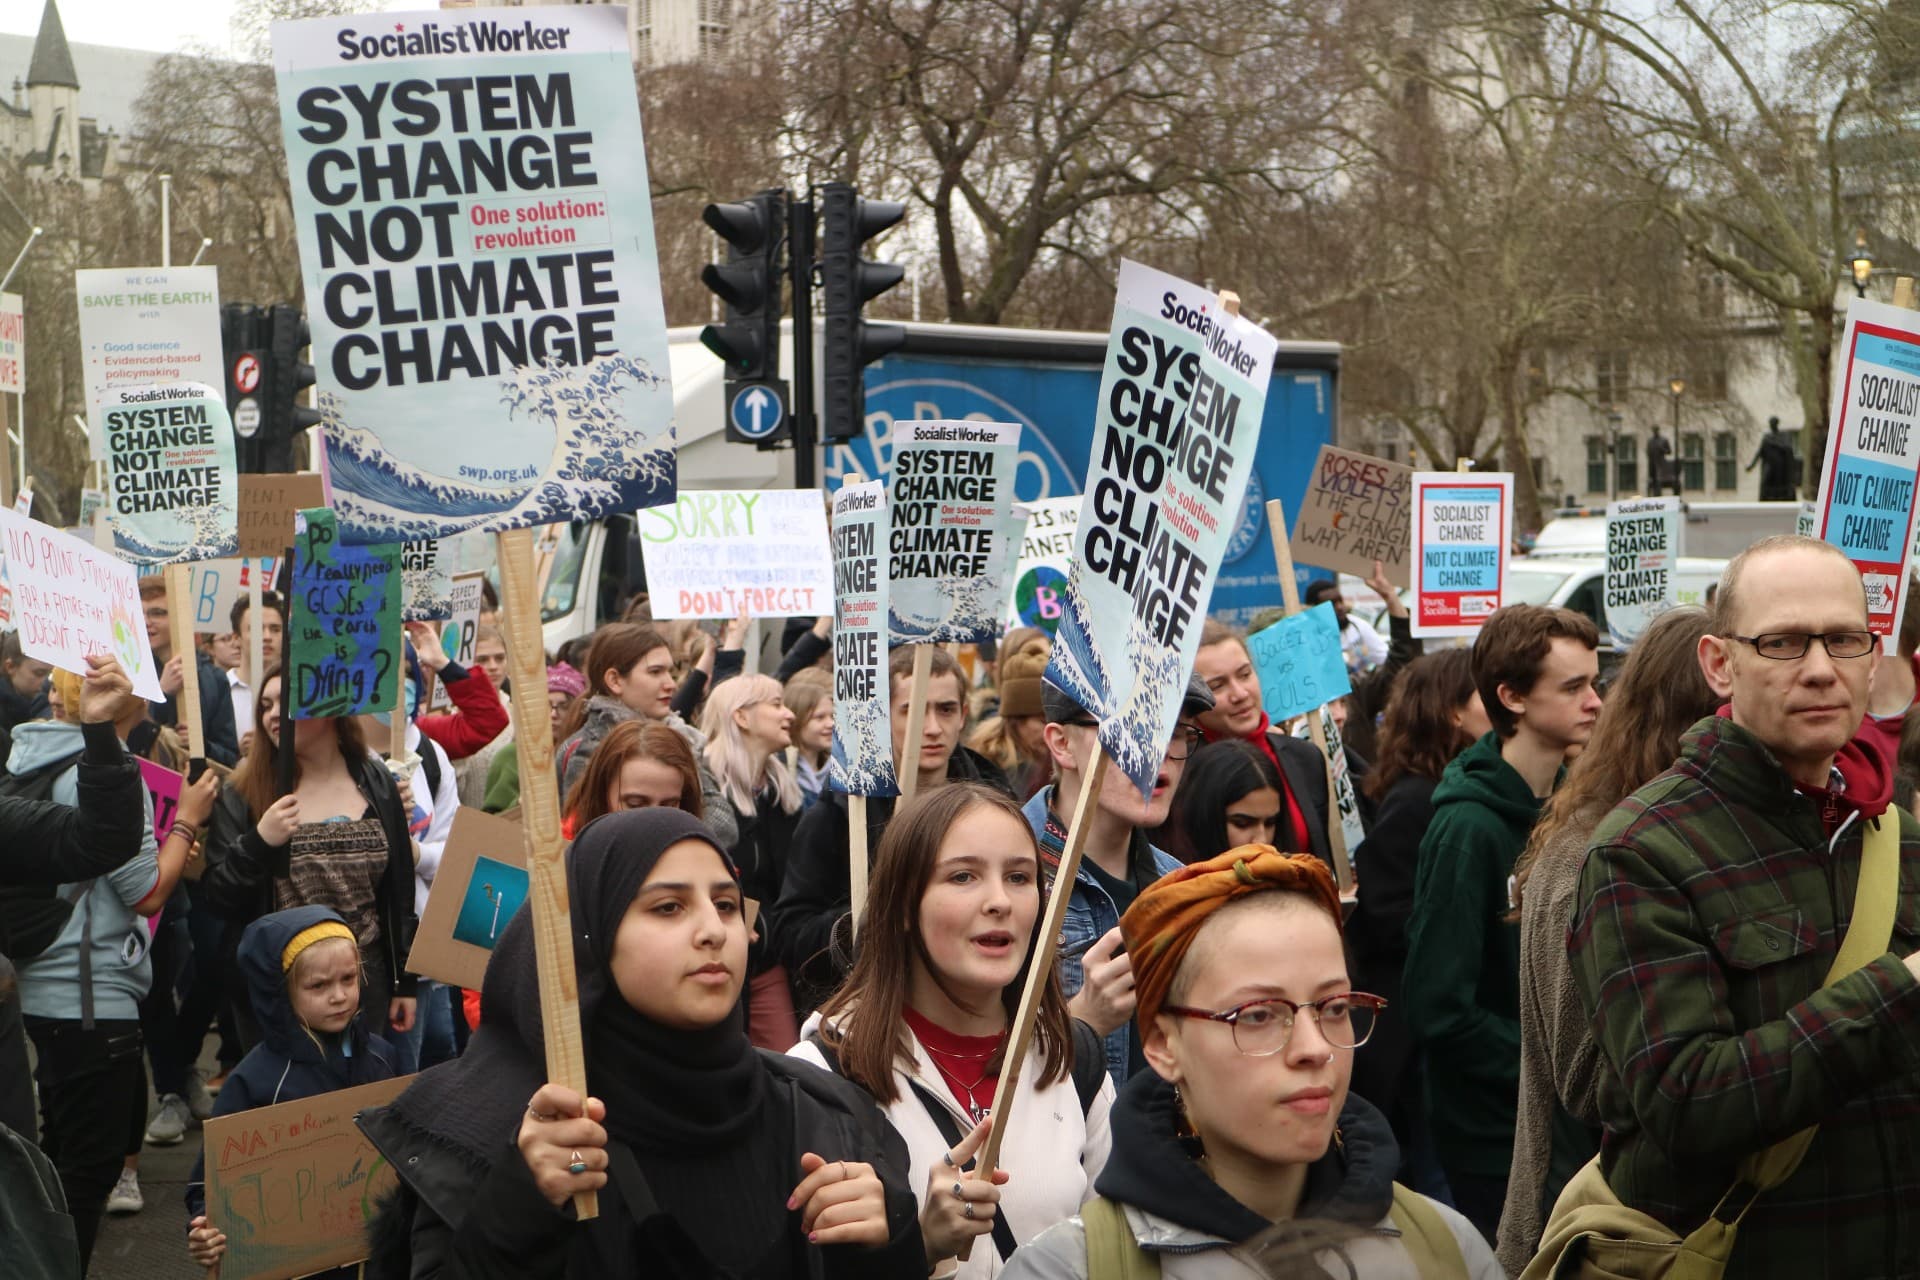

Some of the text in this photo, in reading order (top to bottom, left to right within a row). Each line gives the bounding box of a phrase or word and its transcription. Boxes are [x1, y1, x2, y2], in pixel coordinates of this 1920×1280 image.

[337, 20, 570, 61] Socialist Worker
[297, 71, 577, 145] SYSTEM
[306, 131, 599, 207] CHANGE
[470, 200, 606, 226] One solution:
[314, 200, 460, 270] NOT
[474, 223, 577, 250] revolution
[83, 291, 213, 308] SAVE THE EARTH
[323, 249, 620, 330] CLIMATE
[104, 341, 180, 352] Good science
[104, 353, 202, 366] Evidenced-based
[330, 309, 620, 392] CHANGE
[1209, 325, 1258, 378] Worker
[105, 367, 180, 381] policymaking
[1116, 326, 1242, 448] SYSEM
[120, 387, 206, 404] Socialist Worker
[1858, 373, 1920, 417] SOCIALIST
[107, 404, 207, 432] SYSTEM
[110, 425, 215, 451] CHANGE
[913, 426, 999, 443] Socialist Worker
[1857, 416, 1911, 457] CHANGE
[112, 450, 161, 474] NOT
[165, 450, 180, 459] One
[166, 457, 206, 467] revolution
[895, 449, 995, 476] SYSTEM
[1101, 424, 1170, 494] NO
[115, 466, 222, 494] CLIMATE
[458, 462, 540, 484] swp.org.uk
[1322, 452, 1389, 485] ROSES
[894, 476, 997, 502] CHANGE
[1320, 467, 1400, 507] VIOLETS
[1834, 471, 1913, 514] NOT CLIMATE
[117, 487, 221, 515] CHANGE
[848, 490, 877, 513] Worker
[956, 505, 995, 516] solution:
[1177, 491, 1219, 535] solution:
[1314, 487, 1352, 517] THE
[1433, 505, 1491, 522] SOCIALIST
[642, 493, 762, 543] SORRY
[891, 502, 937, 528] NOT
[1031, 508, 1055, 528] IS
[1608, 517, 1665, 537] SYSTEM
[889, 527, 993, 553] CLIMATE
[1301, 521, 1347, 553] WHY
[1439, 524, 1485, 541] CHANGE
[1608, 535, 1667, 555] CHANGE
[1842, 514, 1894, 552] CHANGE
[8, 528, 35, 569] NO
[41, 536, 73, 579] POINT
[1425, 550, 1496, 567] NOT CLIMATE
[1608, 555, 1637, 573] NOT
[889, 554, 986, 580] CHANGE
[1438, 570, 1483, 586] CHANGE
[1607, 569, 1668, 590] CLIMATE
[18, 584, 40, 612] FOR
[679, 586, 815, 615] DON'T FORGET
[1084, 525, 1191, 652] CHNGE
[1607, 587, 1667, 608] CHANGE
[1036, 585, 1062, 619] B
[333, 617, 377, 637] earth
[335, 642, 348, 661] is
